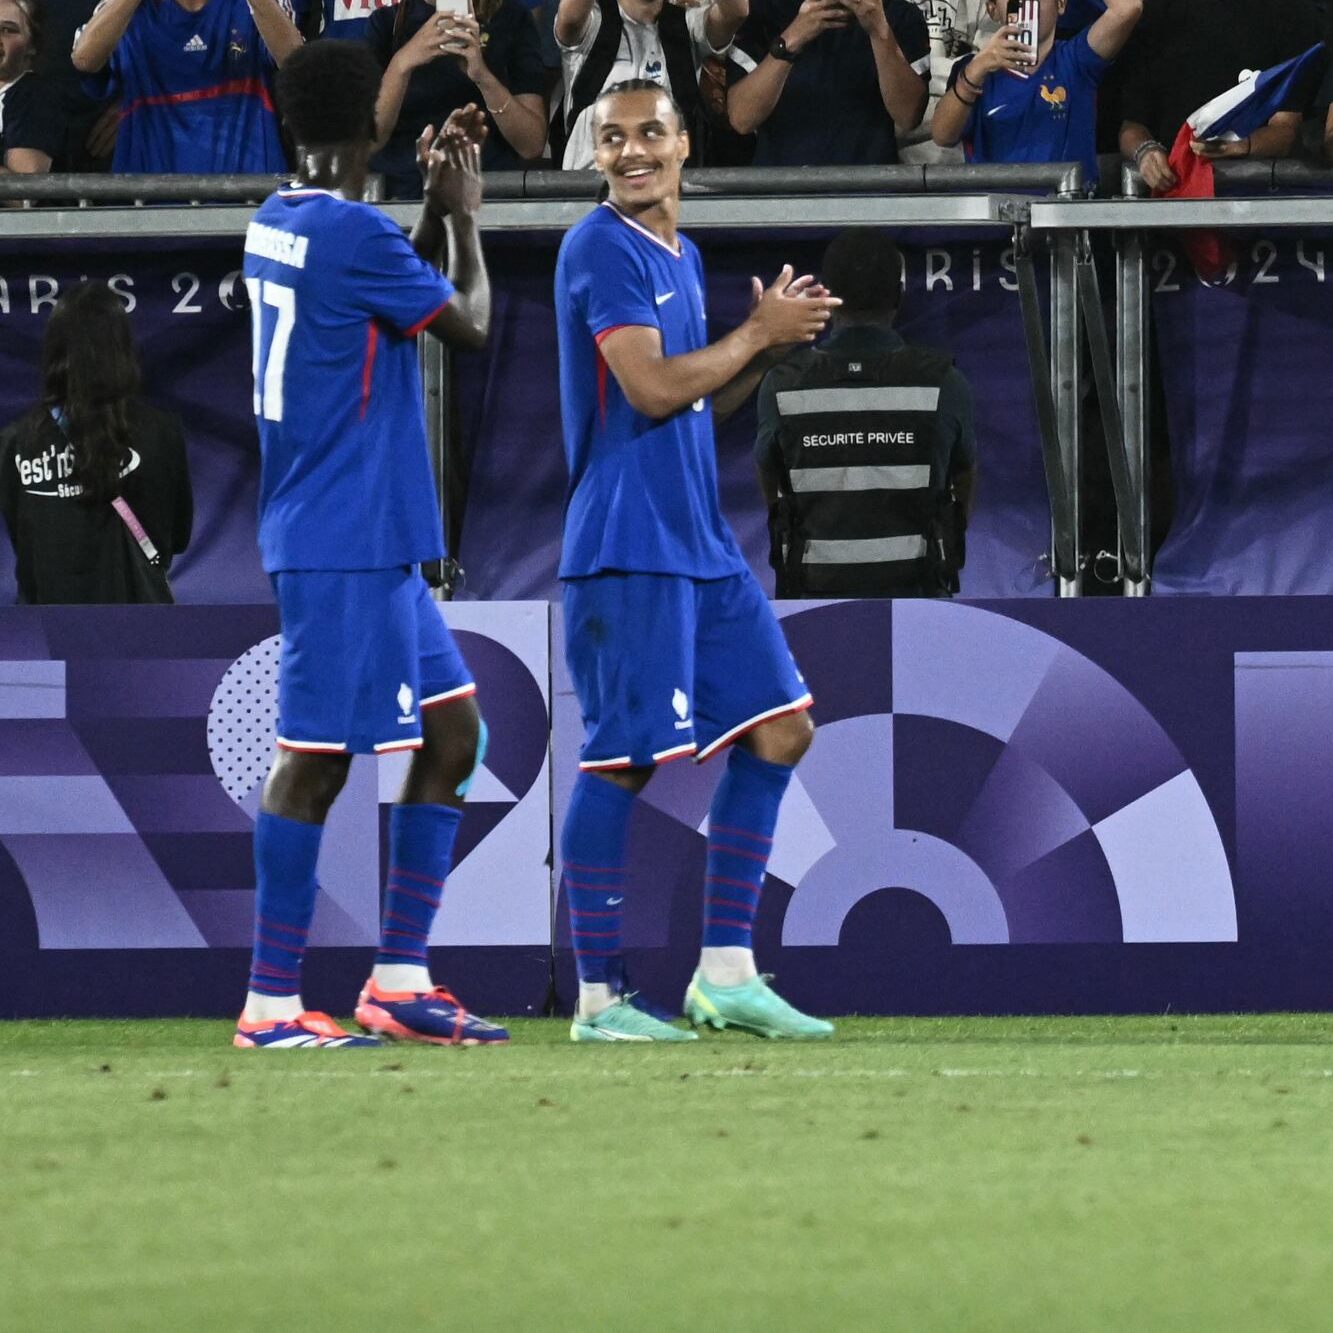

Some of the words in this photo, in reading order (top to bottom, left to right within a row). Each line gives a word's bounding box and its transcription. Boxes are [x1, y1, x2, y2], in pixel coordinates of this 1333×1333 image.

[244, 277, 298, 422] 17
[802, 432, 865, 447] SÉCURITÉ
[867, 431, 914, 445] PRIVÉE
